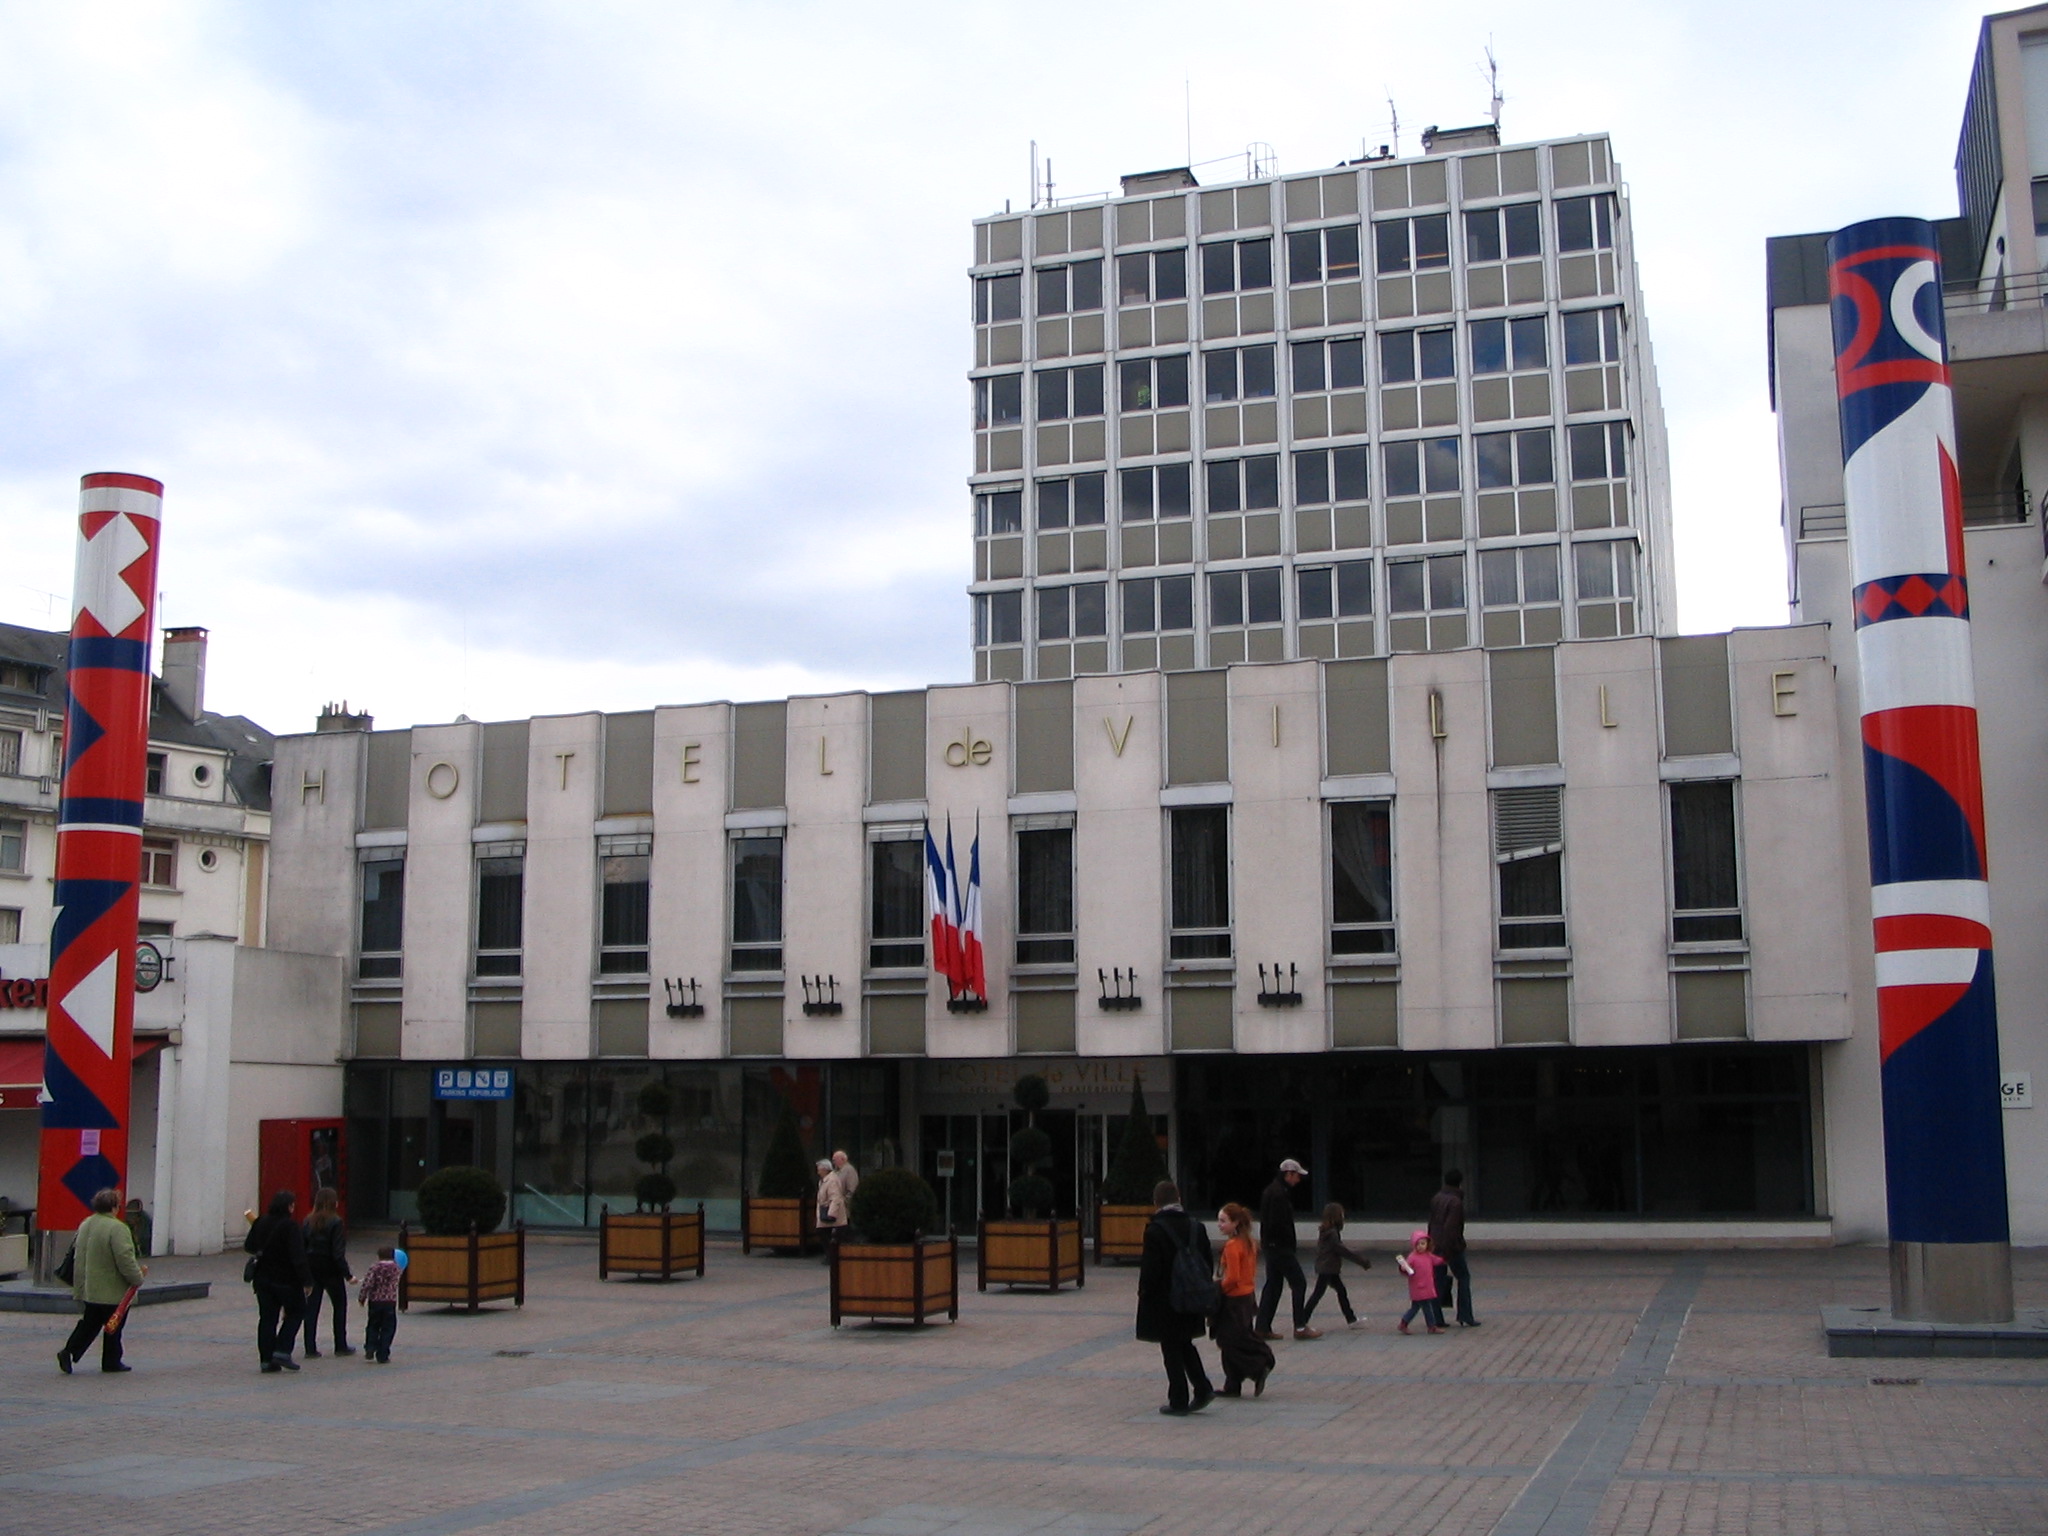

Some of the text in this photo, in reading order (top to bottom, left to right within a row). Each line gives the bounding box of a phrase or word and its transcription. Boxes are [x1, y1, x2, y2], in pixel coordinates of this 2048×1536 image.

[301, 670, 1798, 806] HOTEL de VILLE
